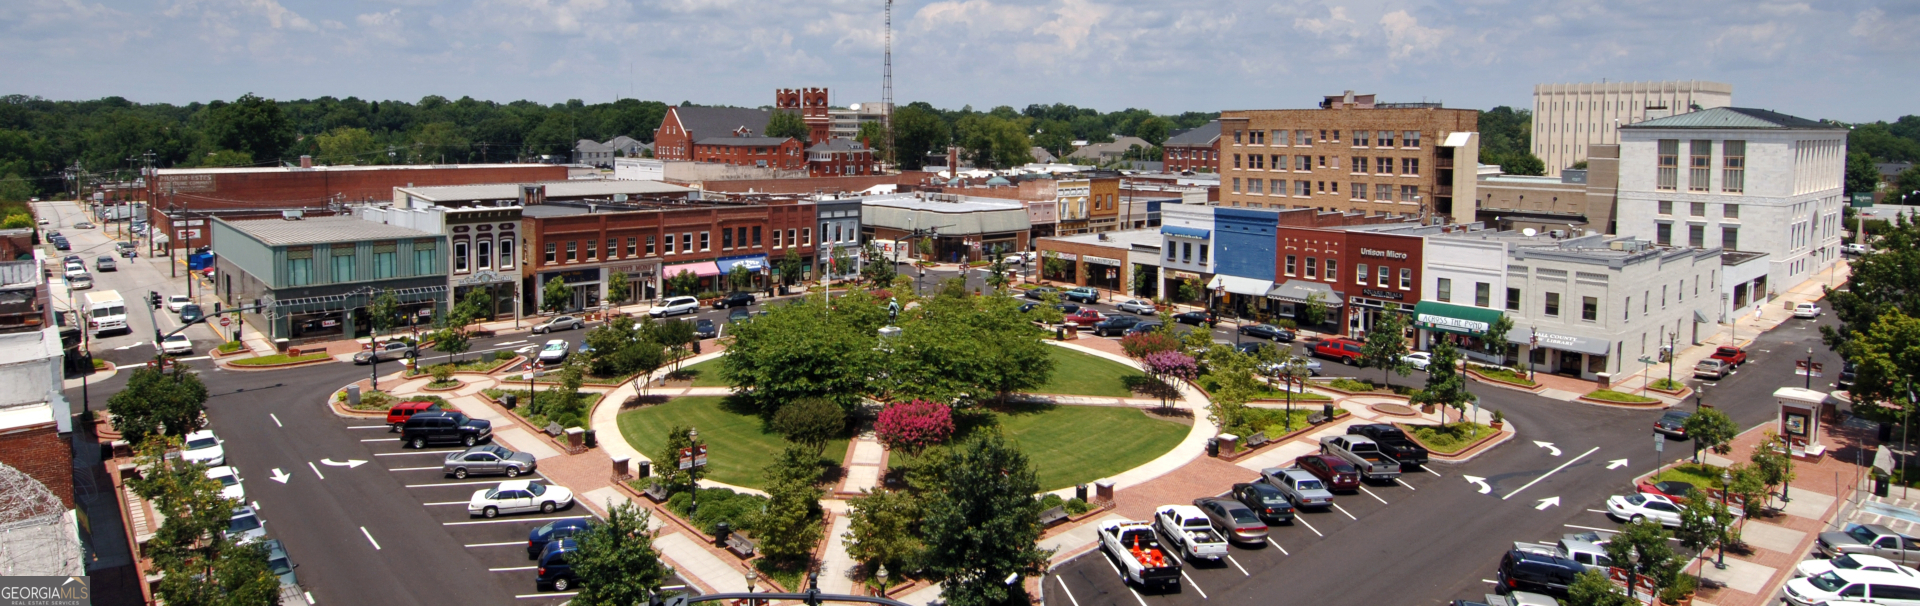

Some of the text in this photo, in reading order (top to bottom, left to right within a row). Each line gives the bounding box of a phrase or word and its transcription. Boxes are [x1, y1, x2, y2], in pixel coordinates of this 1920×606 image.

[876, 242, 892, 252] FedEx
[1360, 247, 1408, 259] Unison Micro
[1363, 288, 1384, 297] SQUARE
[1385, 291, 1403, 299] DEALS
[1422, 315, 1448, 325] ACROSS
[1451, 318, 1462, 327] THE
[1464, 322, 1483, 330] POND
[1546, 338, 1574, 346] LIBRARY
[1549, 334, 1578, 342] COUNTY
